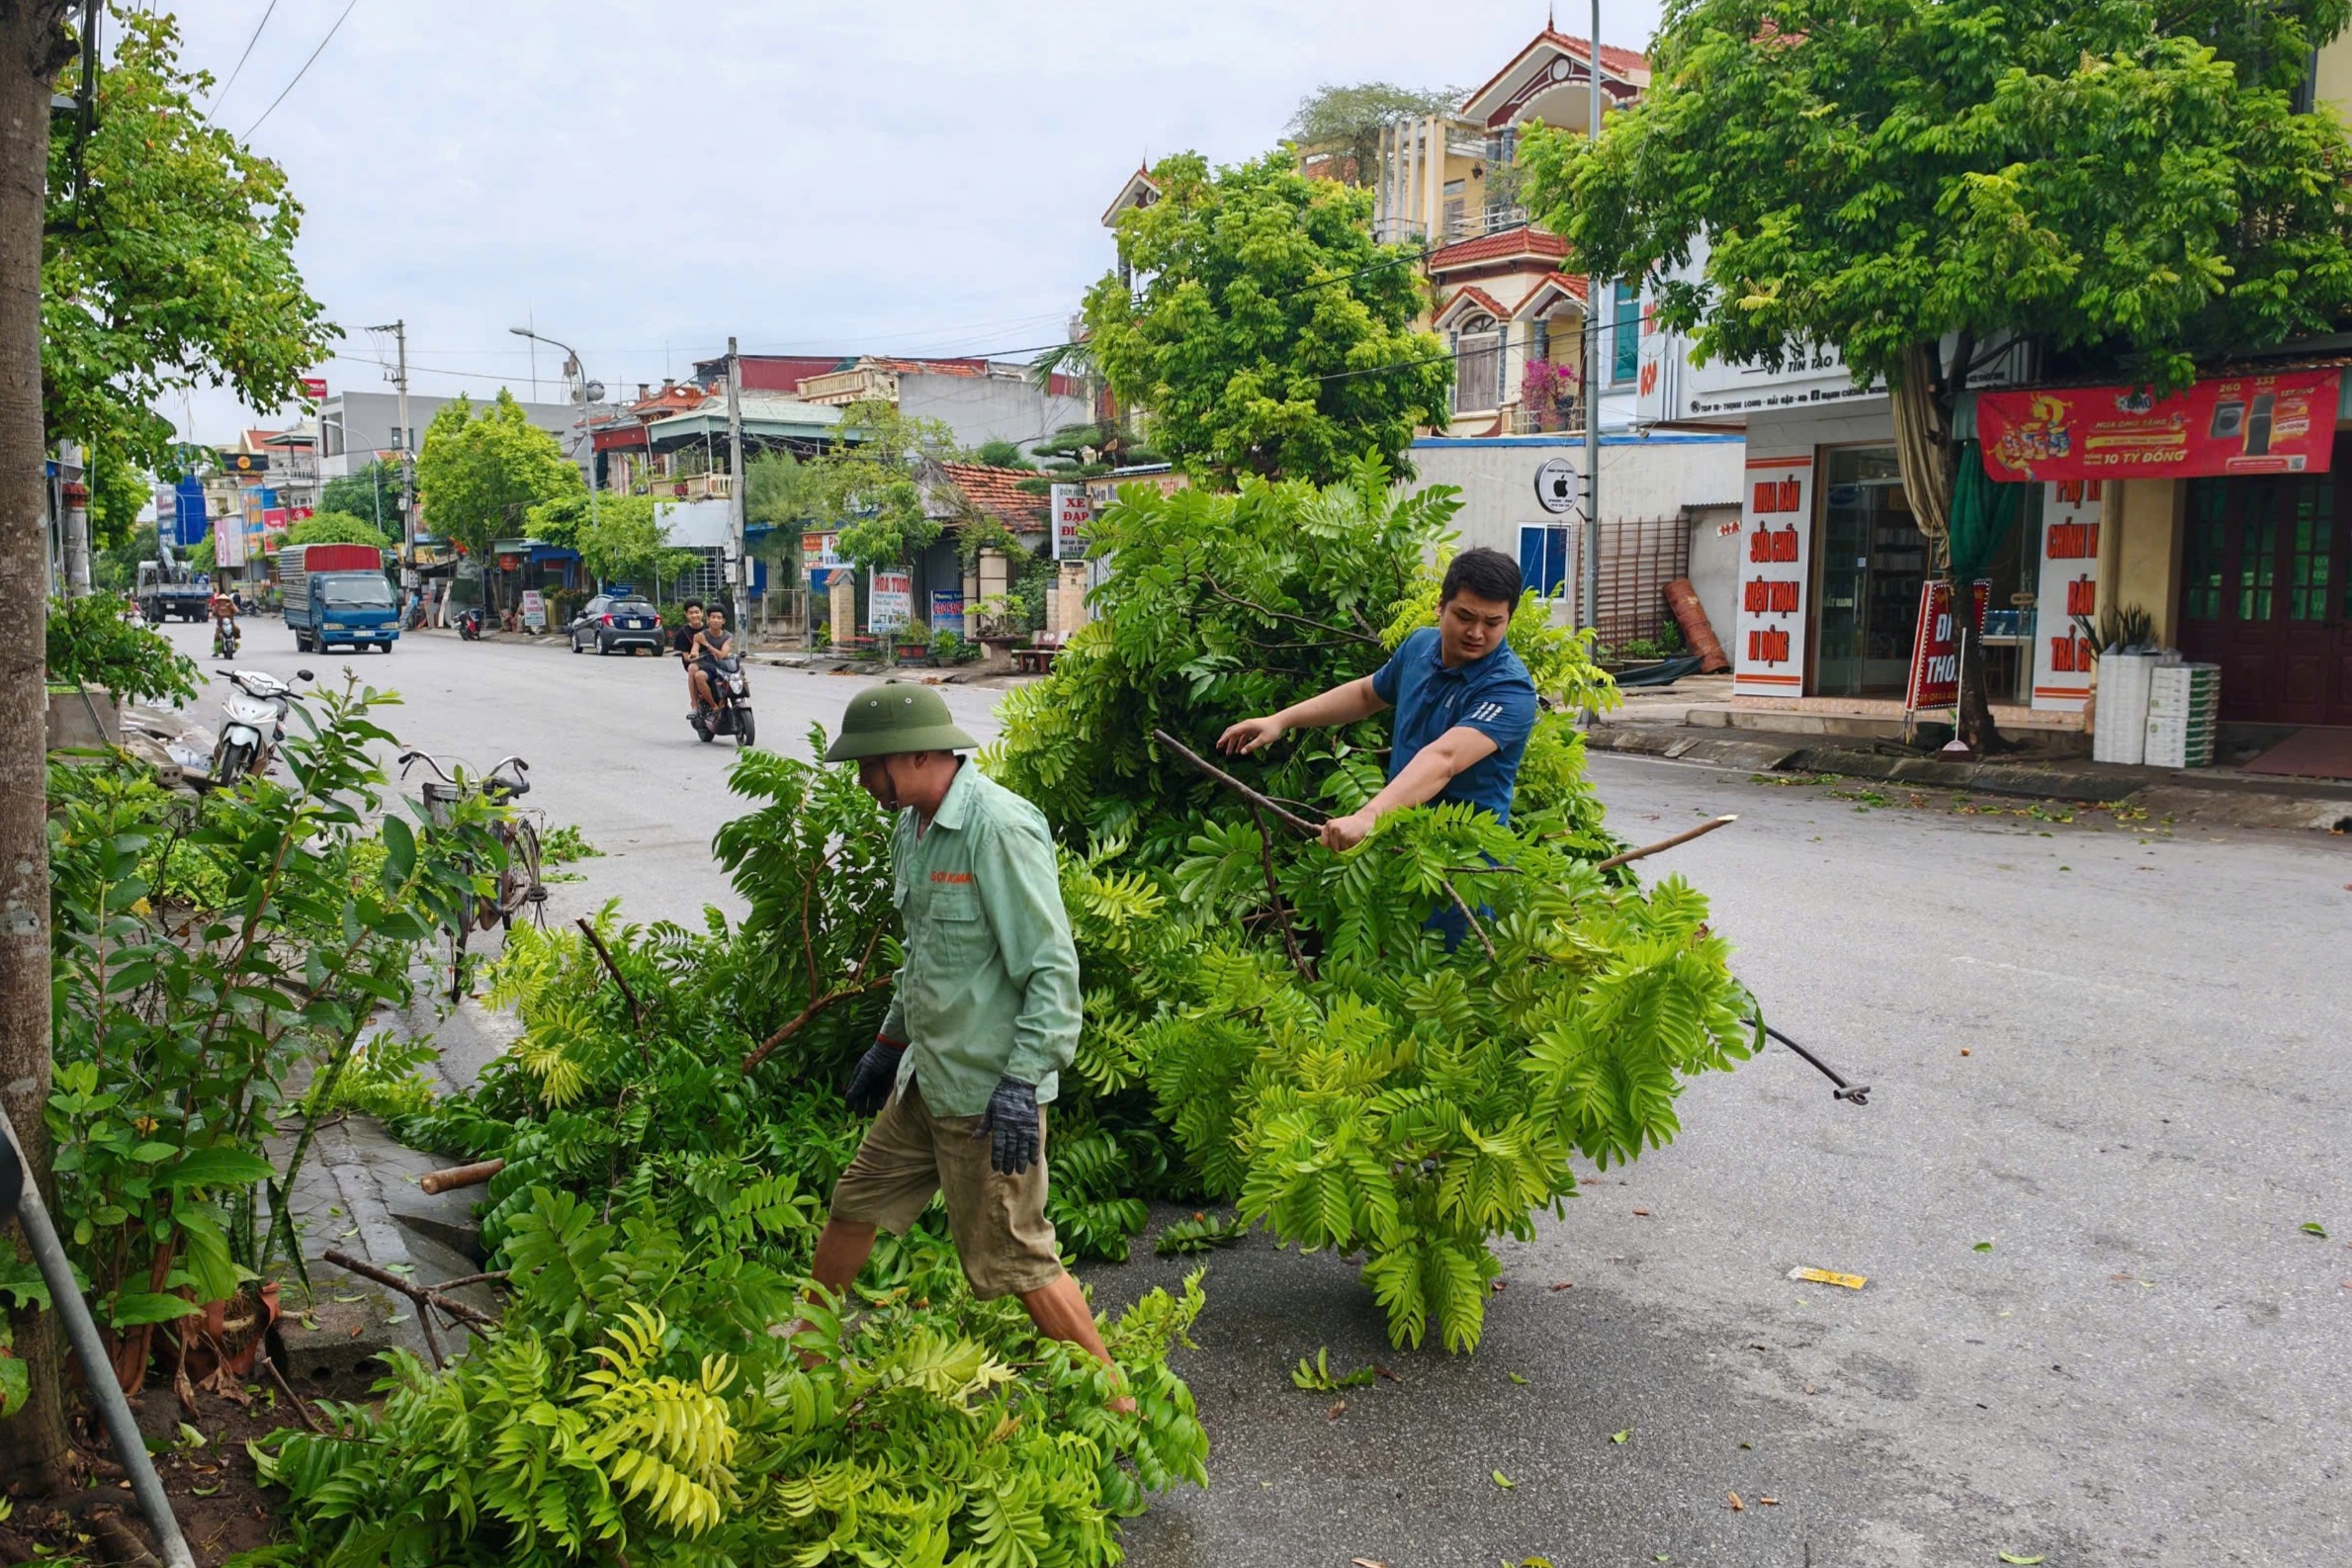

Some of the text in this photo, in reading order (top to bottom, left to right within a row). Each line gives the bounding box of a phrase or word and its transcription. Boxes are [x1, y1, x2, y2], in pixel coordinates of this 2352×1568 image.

[1641, 353, 1658, 397] GÓP
[2219, 383, 2241, 392] 260
[2104, 454, 2119, 465] 10
[1066, 497, 1086, 508] XE
[1753, 475, 1800, 514] MUA BÁN
[1063, 511, 1089, 524] ĐẠP
[1750, 521, 1798, 563] SỬA CHỮA
[2047, 517, 2088, 559] CHÍNH
[874, 576, 890, 592] HOA
[1745, 575, 1799, 618] ĐIỆN THOẠI
[2067, 573, 2096, 616] BÁN
[1749, 625, 1789, 667] DI ĐỘNG
[2050, 625, 2075, 672] TRẢ
[1926, 653, 1957, 684] THO
